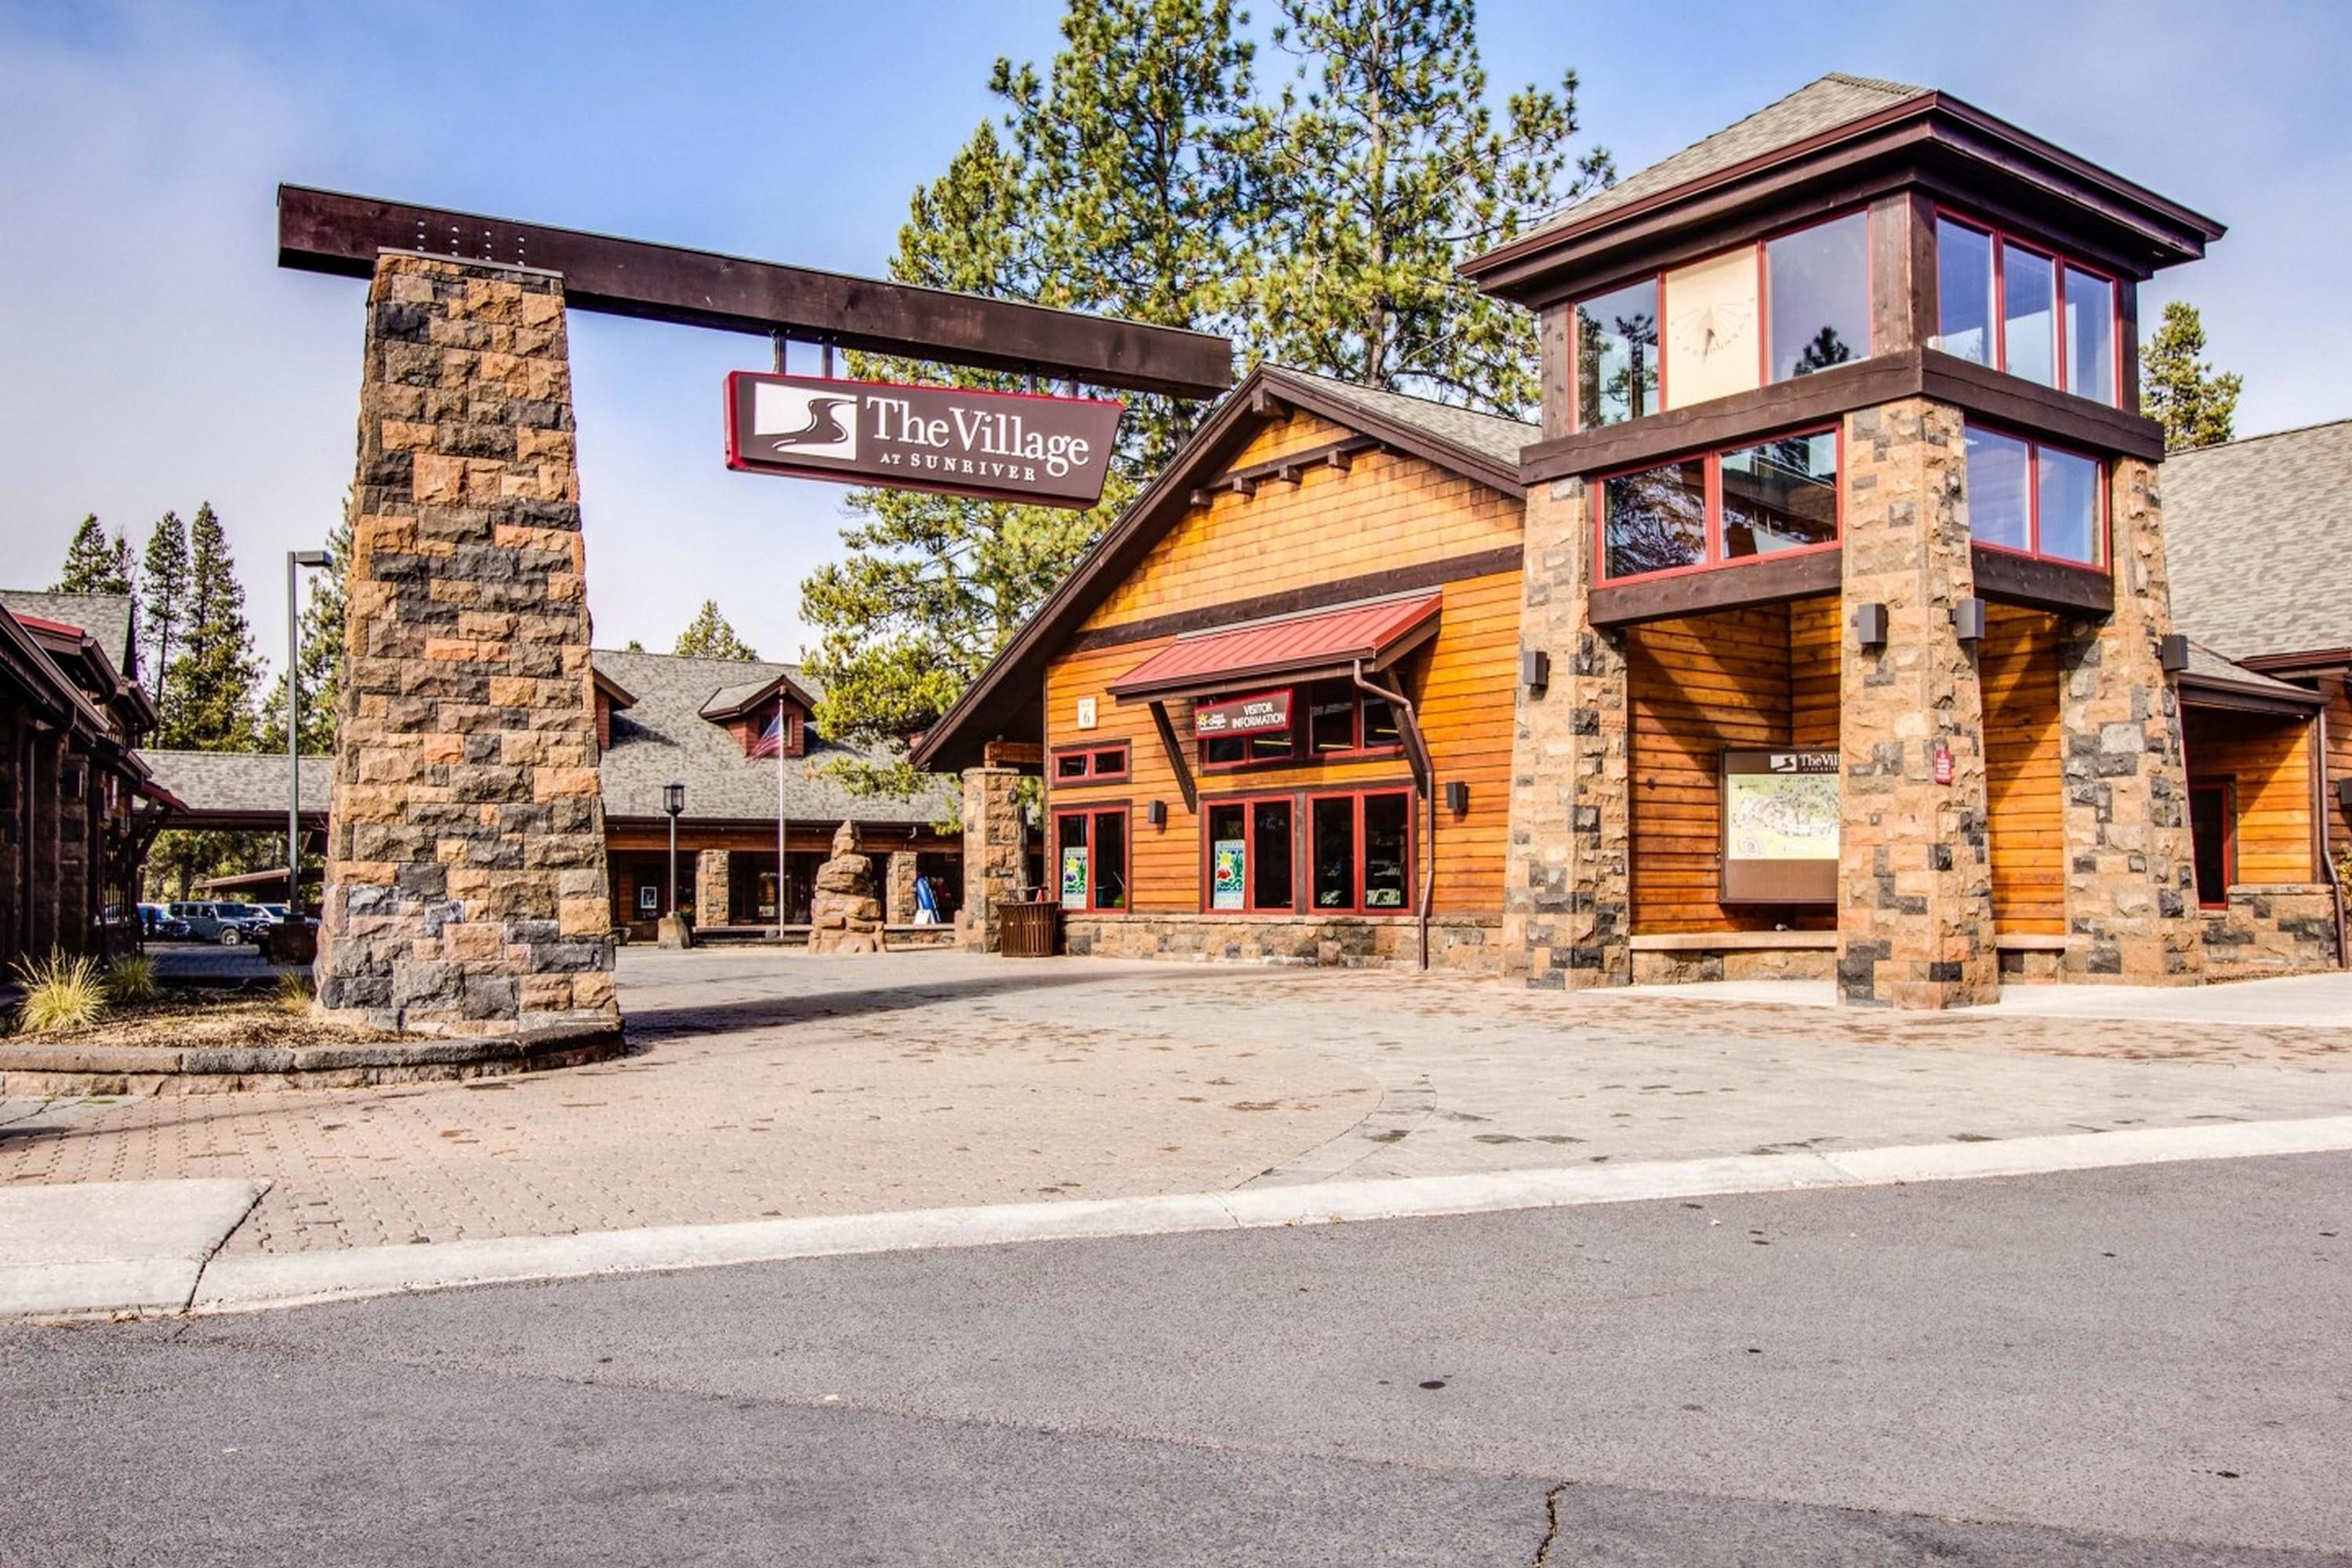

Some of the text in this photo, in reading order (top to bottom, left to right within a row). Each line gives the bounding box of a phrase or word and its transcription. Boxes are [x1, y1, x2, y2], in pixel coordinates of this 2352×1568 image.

[866, 396, 1089, 477] The Village
[880, 452, 1036, 481] AT SUNRIVER
[1243, 702, 1273, 715] VISITOR
[1232, 712, 1287, 729] INFORMATION
[1799, 753, 1822, 766] The
